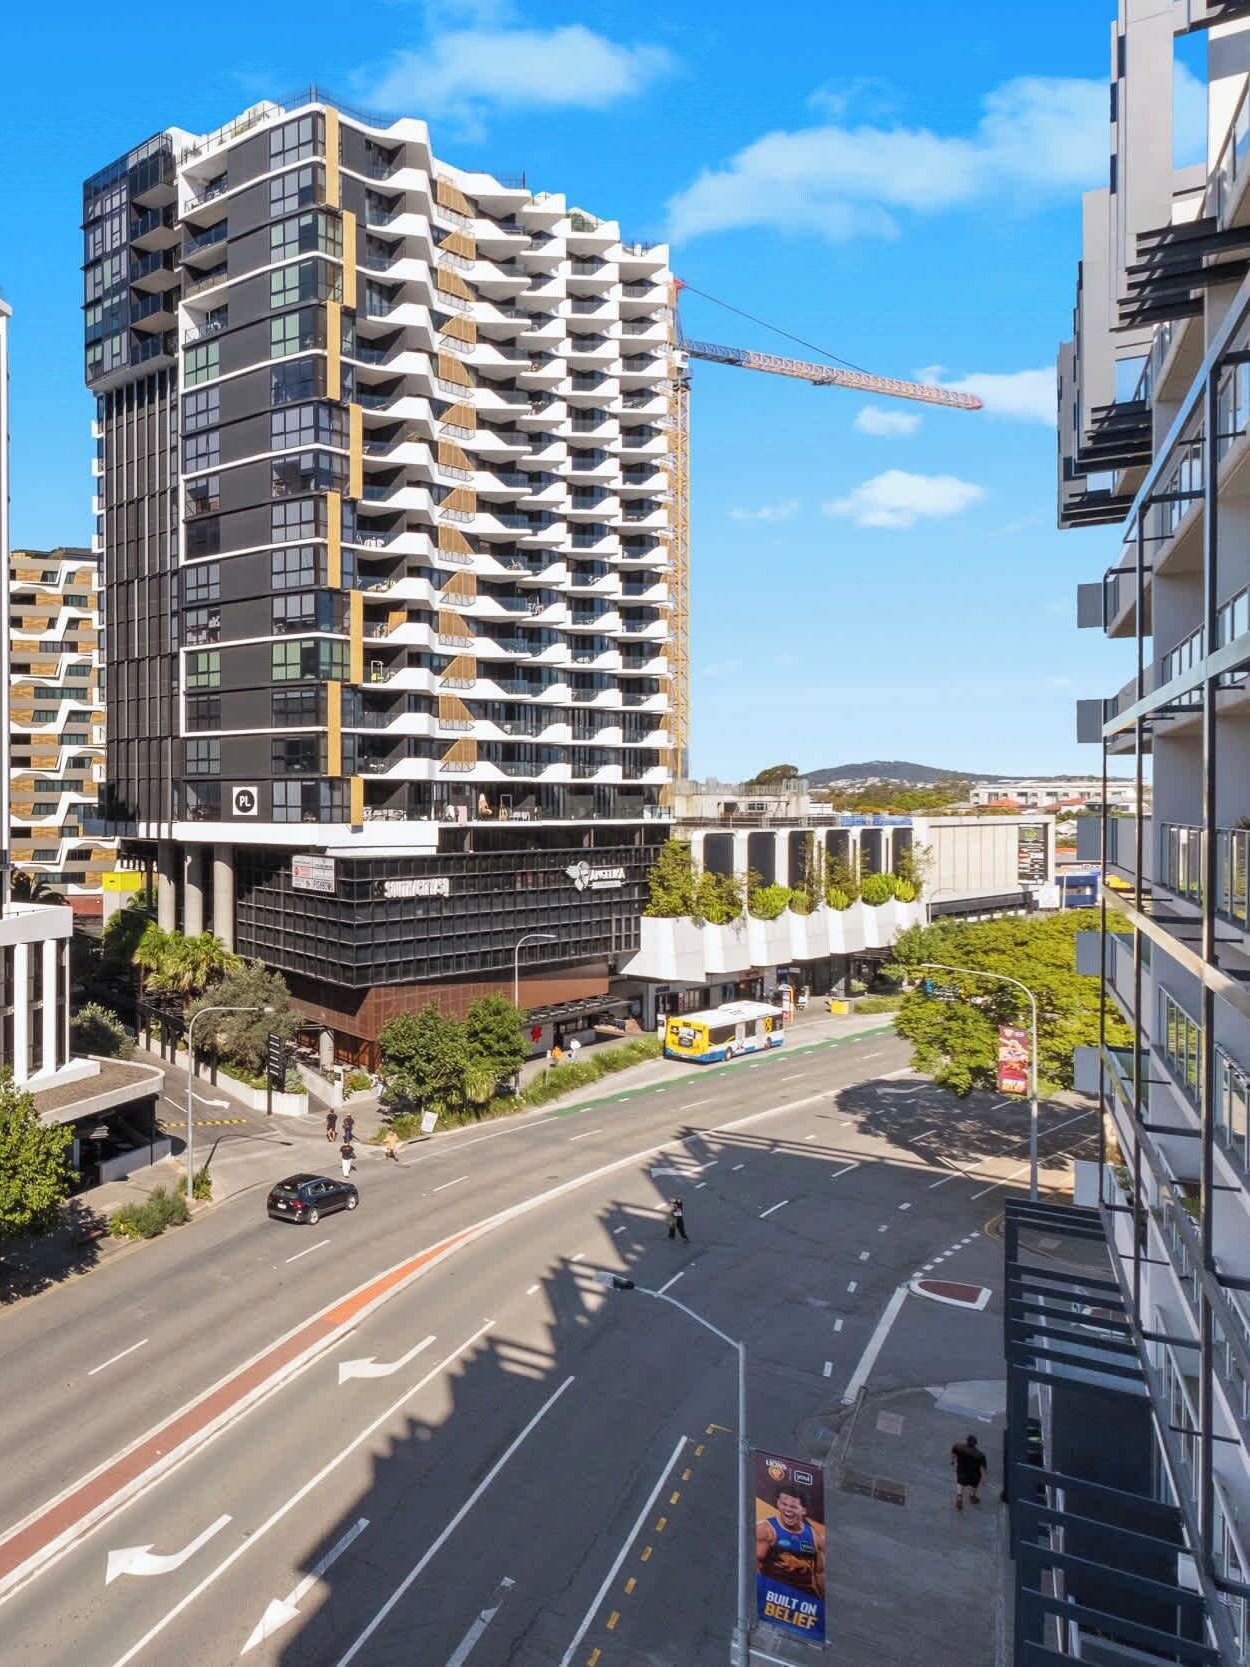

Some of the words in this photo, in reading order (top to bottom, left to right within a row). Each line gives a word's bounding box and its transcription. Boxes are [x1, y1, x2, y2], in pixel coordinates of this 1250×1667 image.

[239, 795, 251, 806] PL
[765, 1590, 799, 1610] BUILT
[800, 1601, 818, 1616] ON
[765, 1602, 818, 1629] BELIEF
